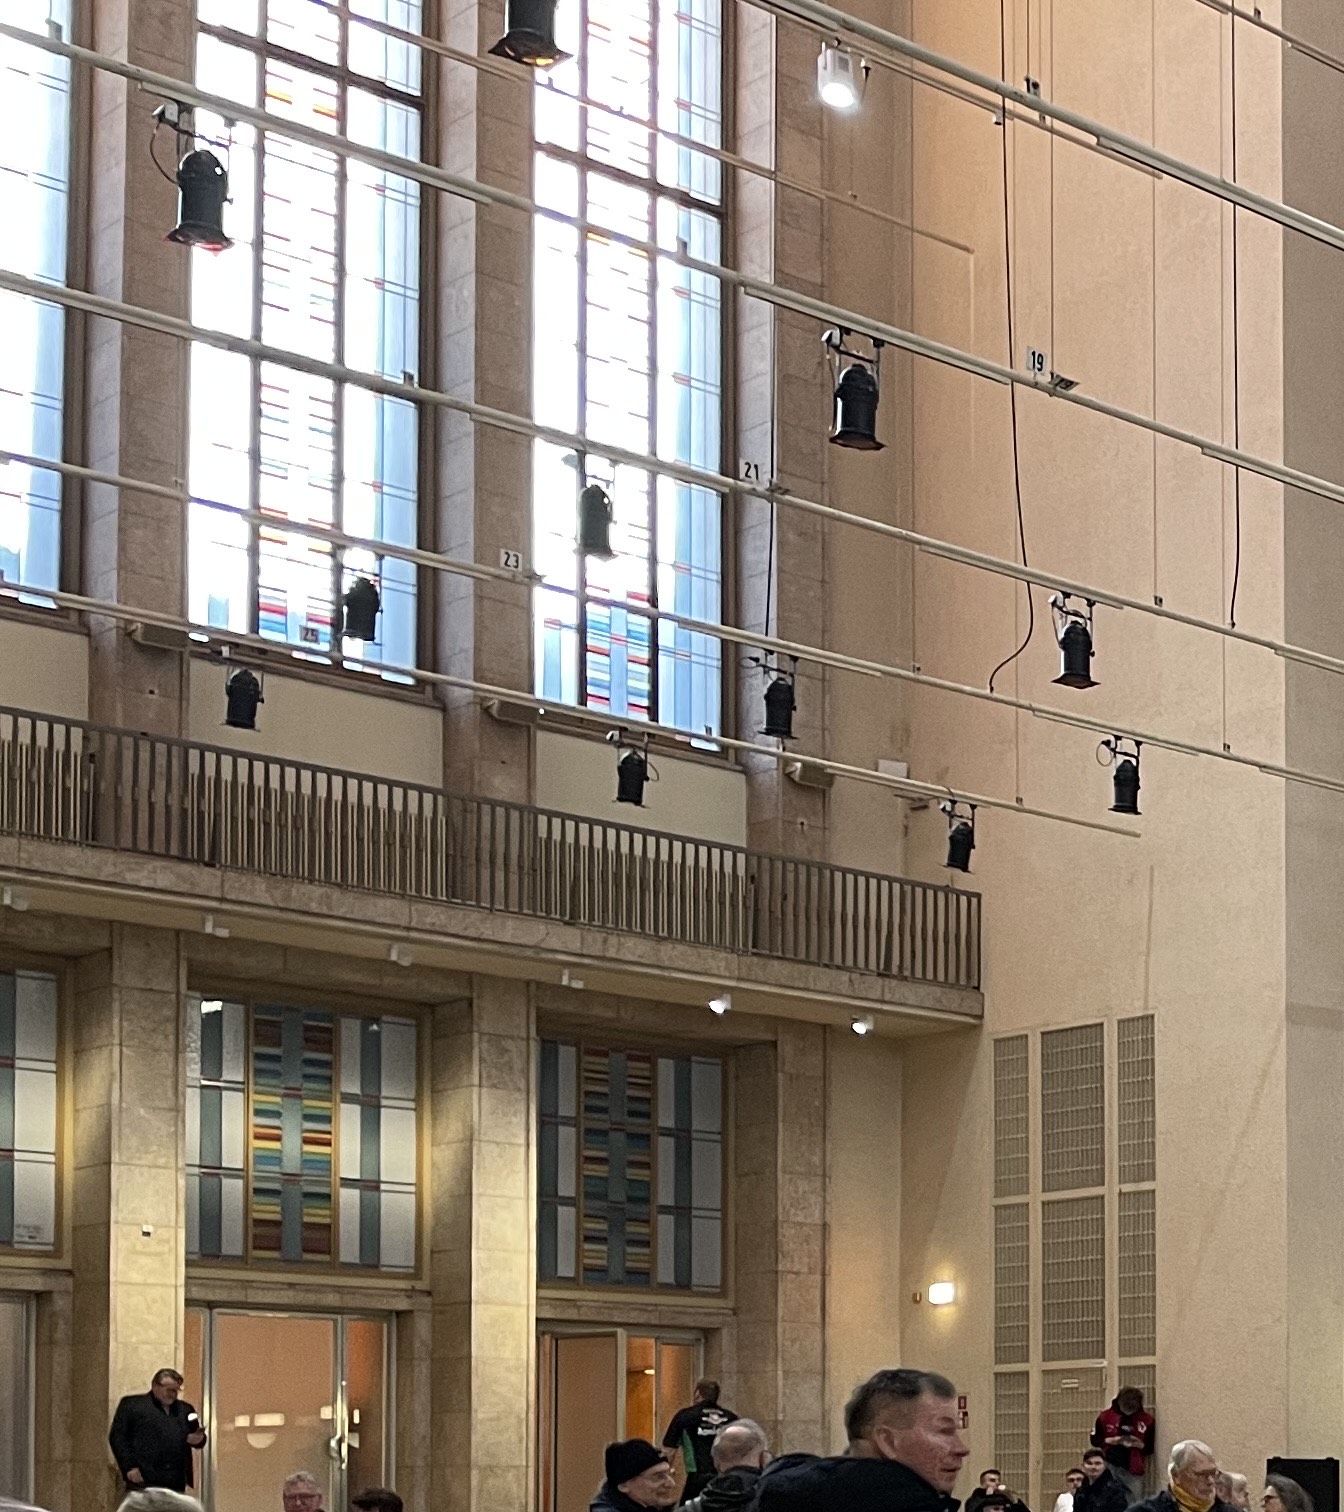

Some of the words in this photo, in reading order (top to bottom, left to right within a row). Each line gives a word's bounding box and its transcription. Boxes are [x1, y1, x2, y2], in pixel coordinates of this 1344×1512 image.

[1031, 350, 1044, 372] 19
[744, 461, 759, 480] 21
[504, 551, 519, 569] 23
